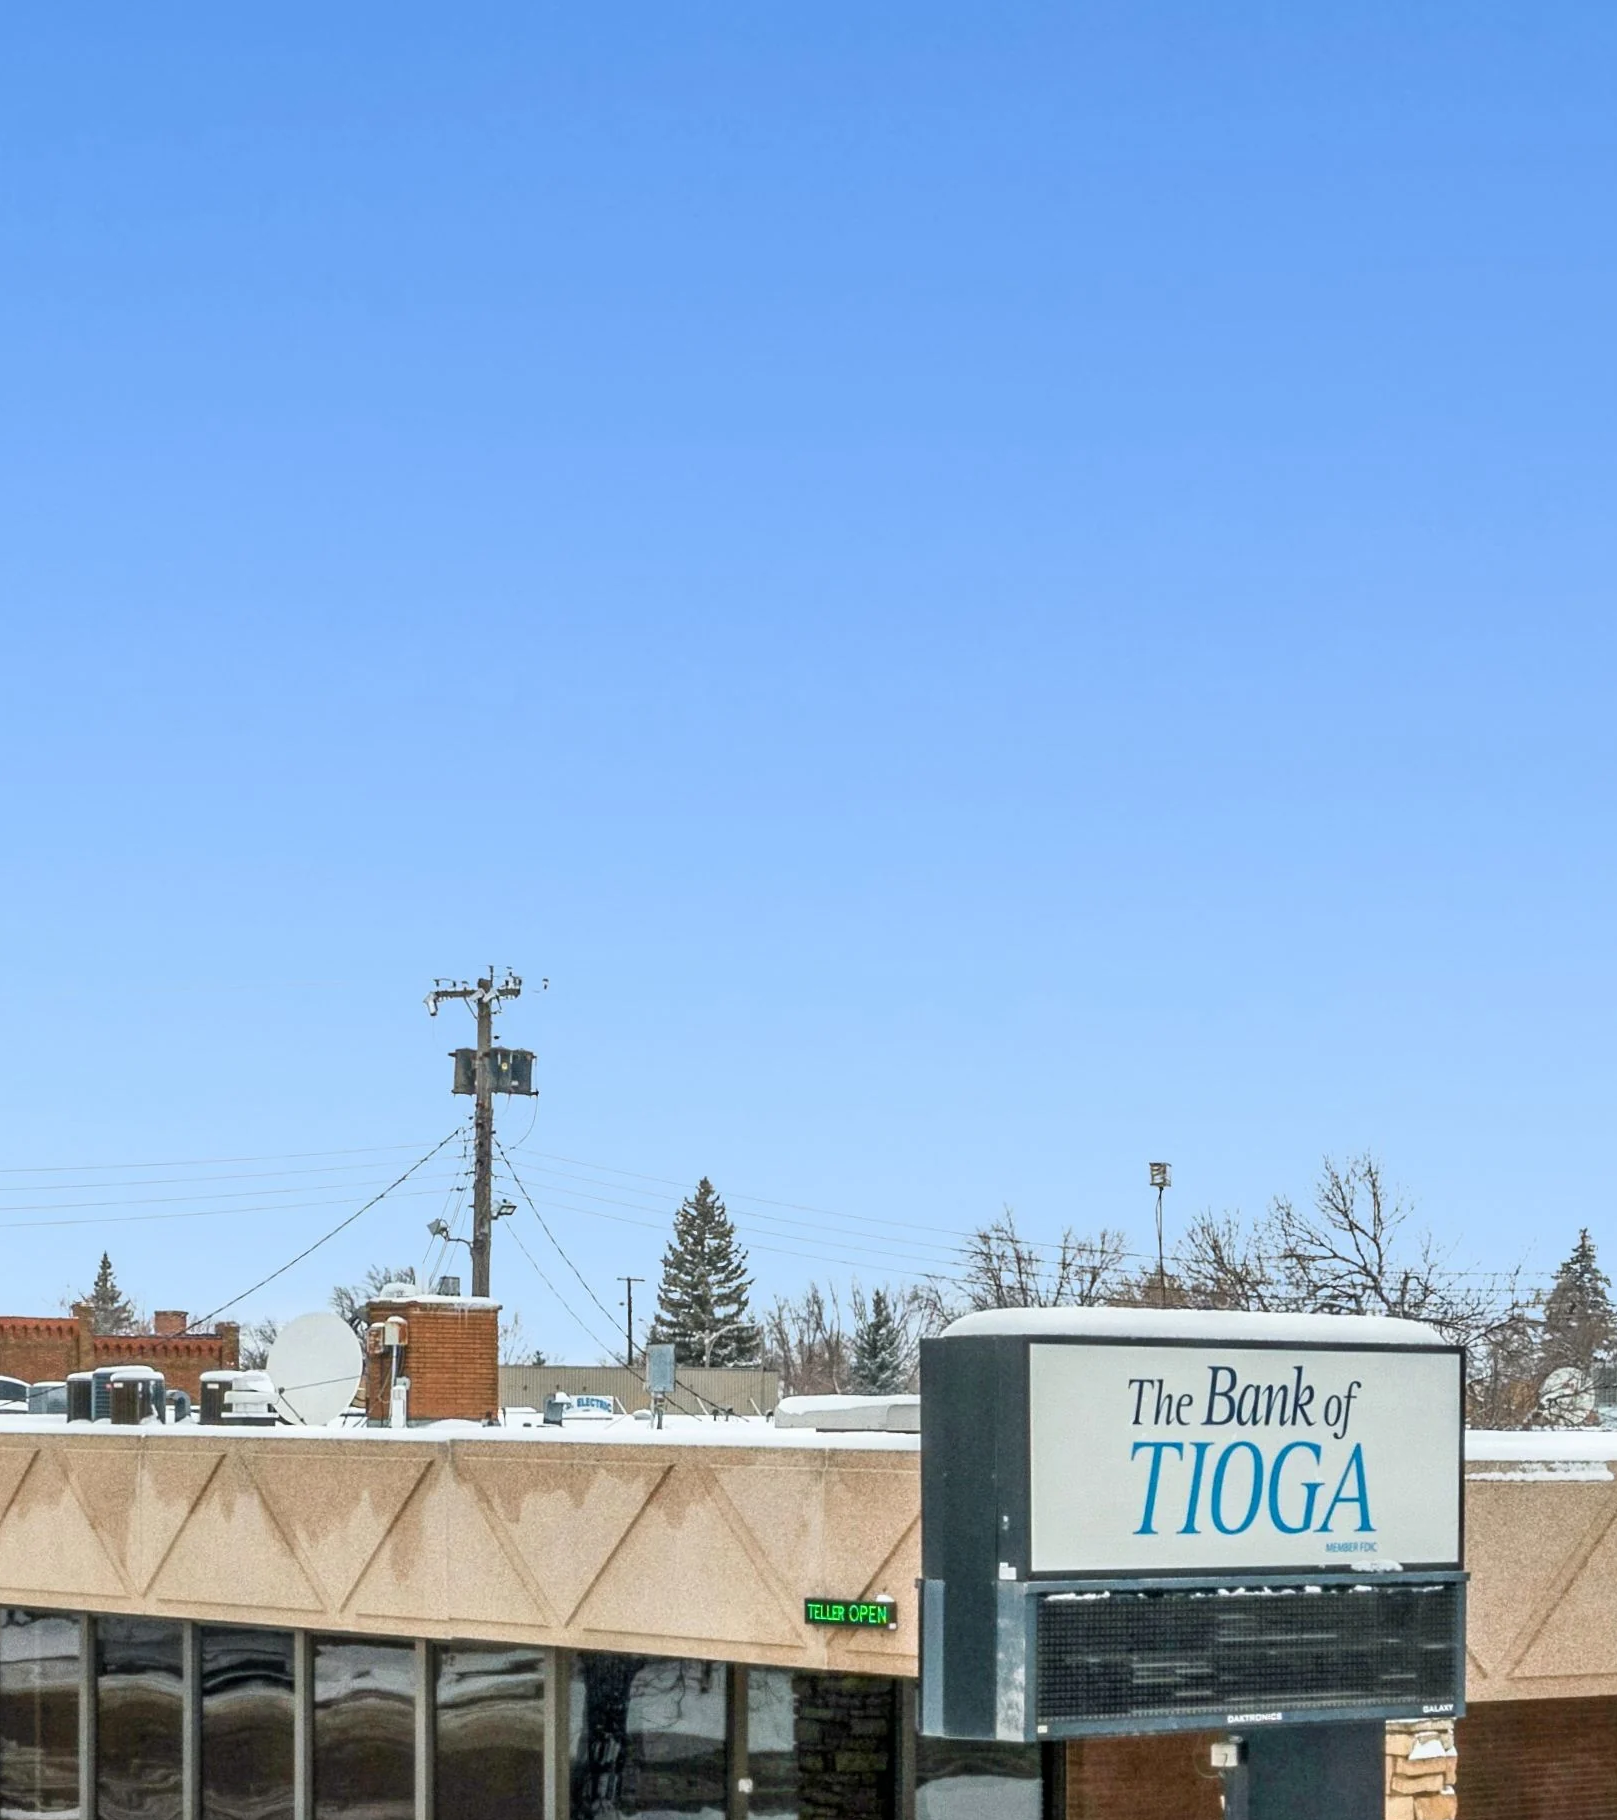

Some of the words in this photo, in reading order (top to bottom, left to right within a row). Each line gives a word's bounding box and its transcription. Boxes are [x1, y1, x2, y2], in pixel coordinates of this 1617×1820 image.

[577, 1397, 612, 1413] ELECTRIC
[1128, 1379, 1194, 1426] The
[1200, 1365, 1316, 1427] Bank
[1324, 1381, 1362, 1440] of
[1130, 1441, 1377, 1536] TIOGA
[1325, 1542, 1358, 1552] MEMBER
[807, 1604, 845, 1621] TELLER
[848, 1605, 887, 1624] OPEN
[1422, 1704, 1454, 1713] GALAXY
[1227, 1712, 1282, 1723] DAKTRONICS
